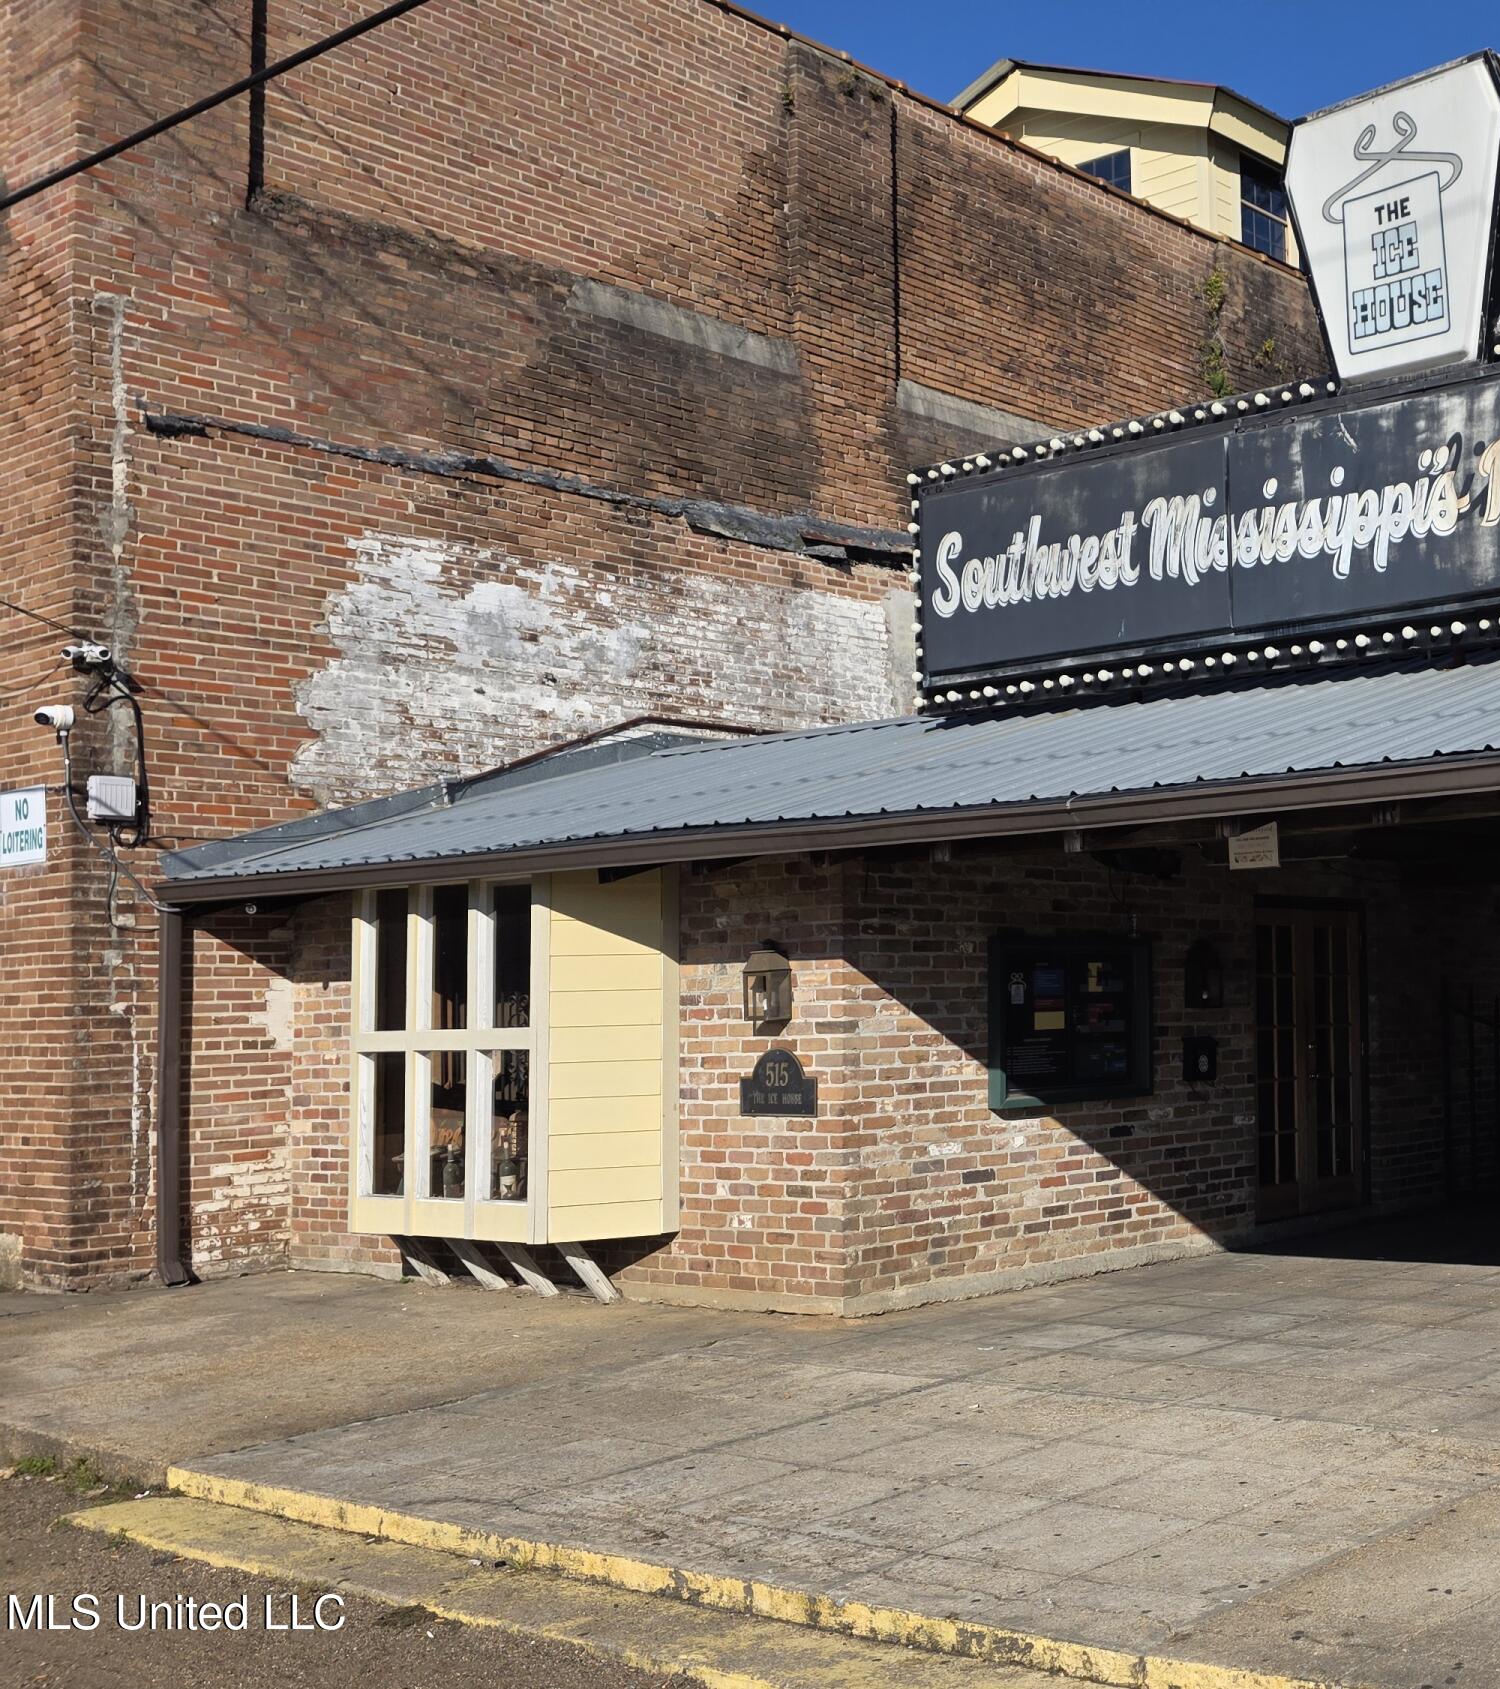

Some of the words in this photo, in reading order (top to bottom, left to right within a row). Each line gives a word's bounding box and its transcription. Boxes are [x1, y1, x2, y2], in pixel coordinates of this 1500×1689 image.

[1374, 197, 1410, 225] THE
[1371, 221, 1419, 280] ICE
[1352, 268, 1444, 339] HOUSE
[932, 511, 1142, 618] Southwest
[15, 798, 29, 821] NO
[3, 827, 43, 854] LOITERING
[766, 1062, 789, 1086] 515
